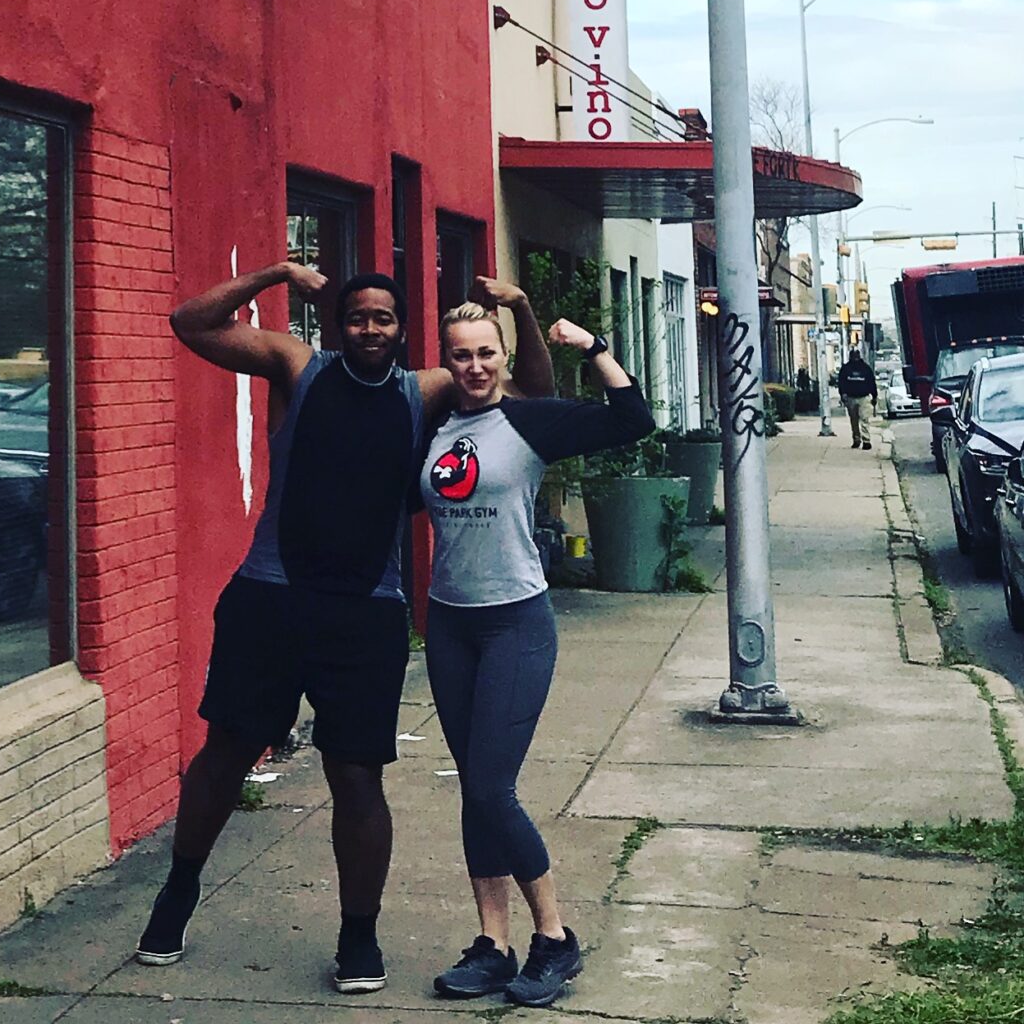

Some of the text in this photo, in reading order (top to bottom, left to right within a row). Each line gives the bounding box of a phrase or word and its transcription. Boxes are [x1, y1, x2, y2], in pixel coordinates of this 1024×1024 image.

[583, 26, 612, 141] vino
[449, 506, 473, 518] PARK
[474, 506, 498, 518] GYM
